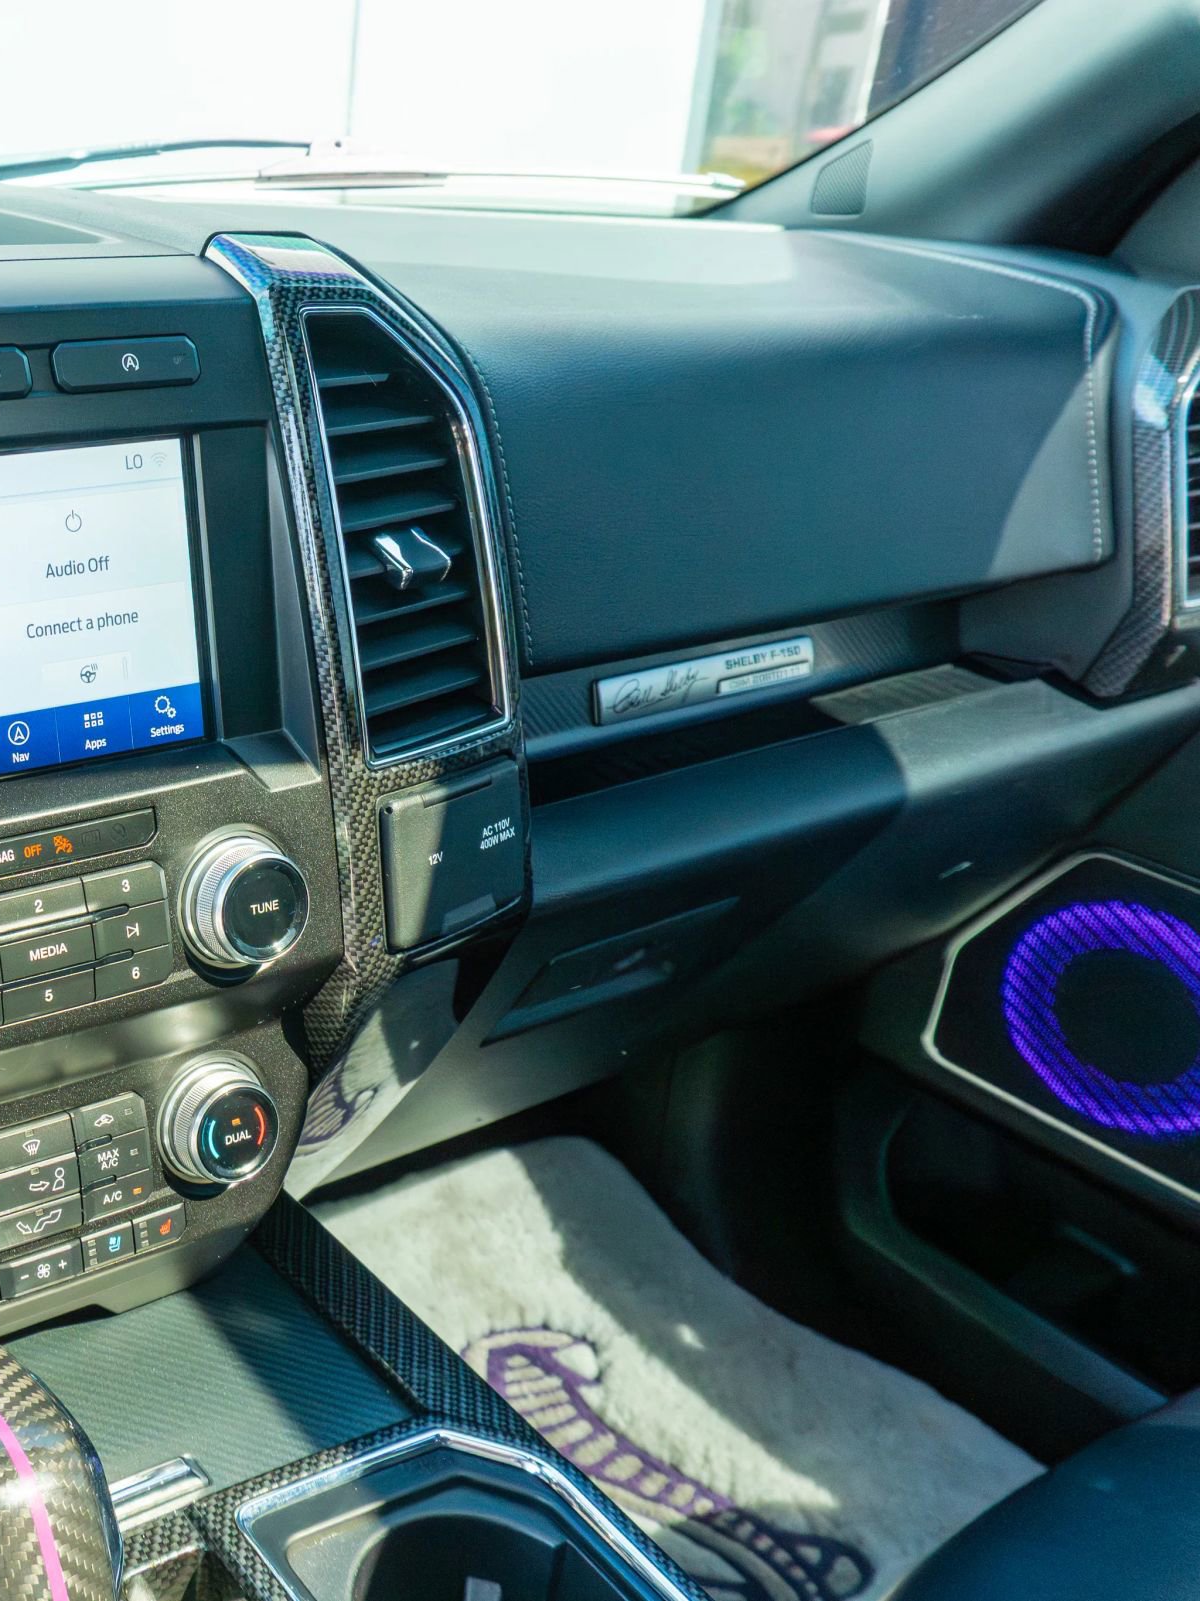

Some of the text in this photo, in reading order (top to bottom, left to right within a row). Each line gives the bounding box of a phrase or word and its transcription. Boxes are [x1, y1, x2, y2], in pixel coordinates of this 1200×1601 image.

[125, 454, 144, 470] LO
[45, 555, 110, 579] Audio Off
[26, 611, 139, 639] Connect a phone
[725, 650, 768, 670] SHELBY
[150, 722, 185, 738] Settings
[85, 738, 107, 751] Apps
[12, 751, 30, 763] Nav
[482, 817, 510, 837] AC 110V
[480, 826, 515, 850] 400W MAX
[23, 844, 42, 858] OFF
[428, 851, 443, 866] 12V
[121, 879, 131, 893] 3
[34, 900, 44, 913] 2
[250, 899, 280, 914] TUNE
[29, 943, 68, 962] MEDIA
[131, 966, 141, 979] 6
[44, 989, 53, 1002] 5
[225, 1128, 252, 1145] DUAL
[97, 1148, 120, 1163] MAX
[101, 1157, 119, 1170] A/C
[103, 1191, 123, 1204] A/C
